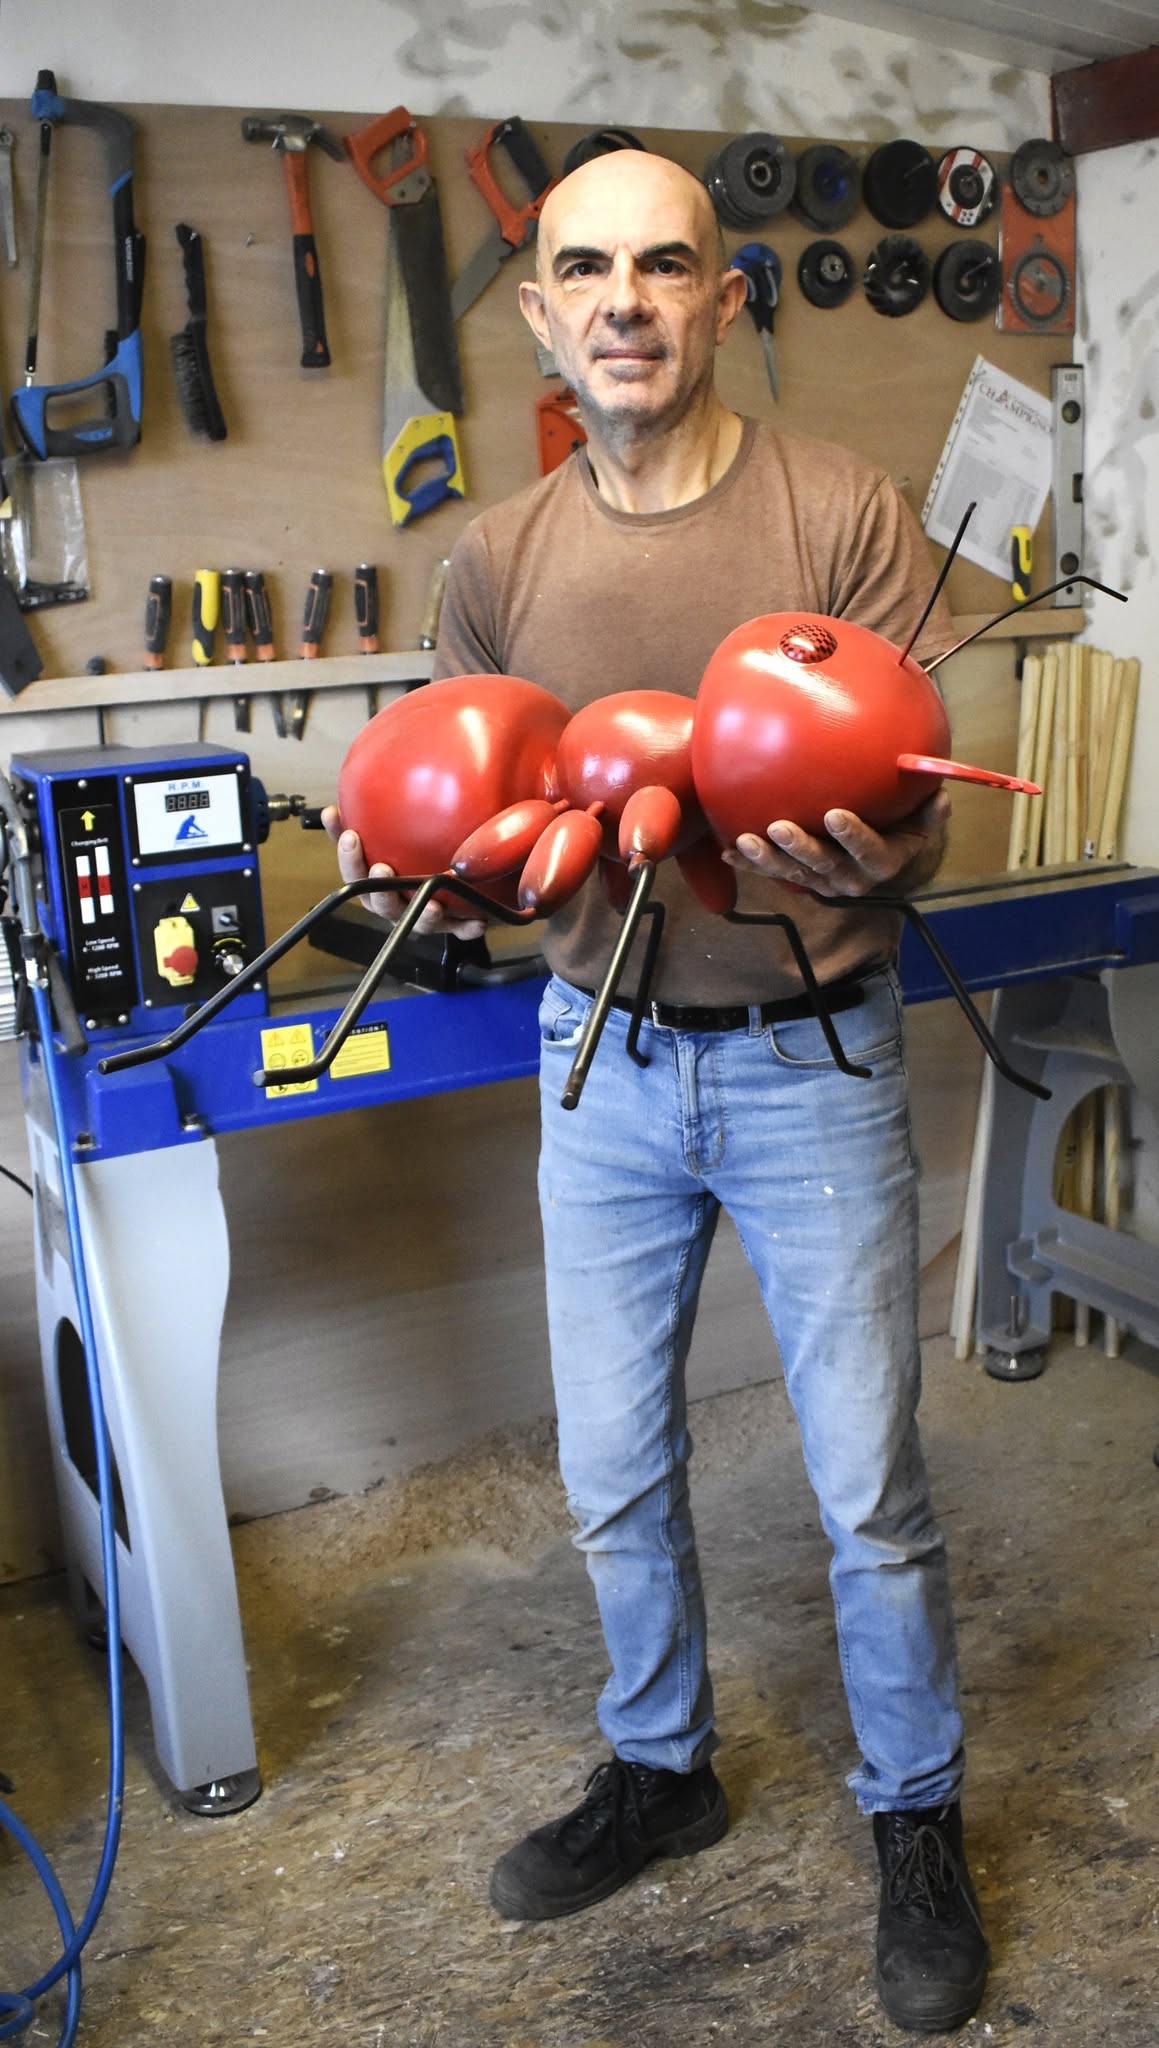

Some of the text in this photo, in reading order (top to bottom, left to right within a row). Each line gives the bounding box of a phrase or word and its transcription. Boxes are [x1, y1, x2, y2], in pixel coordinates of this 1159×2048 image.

[98, 936, 115, 945] Speed
[87, 963, 119, 974] High Speed
